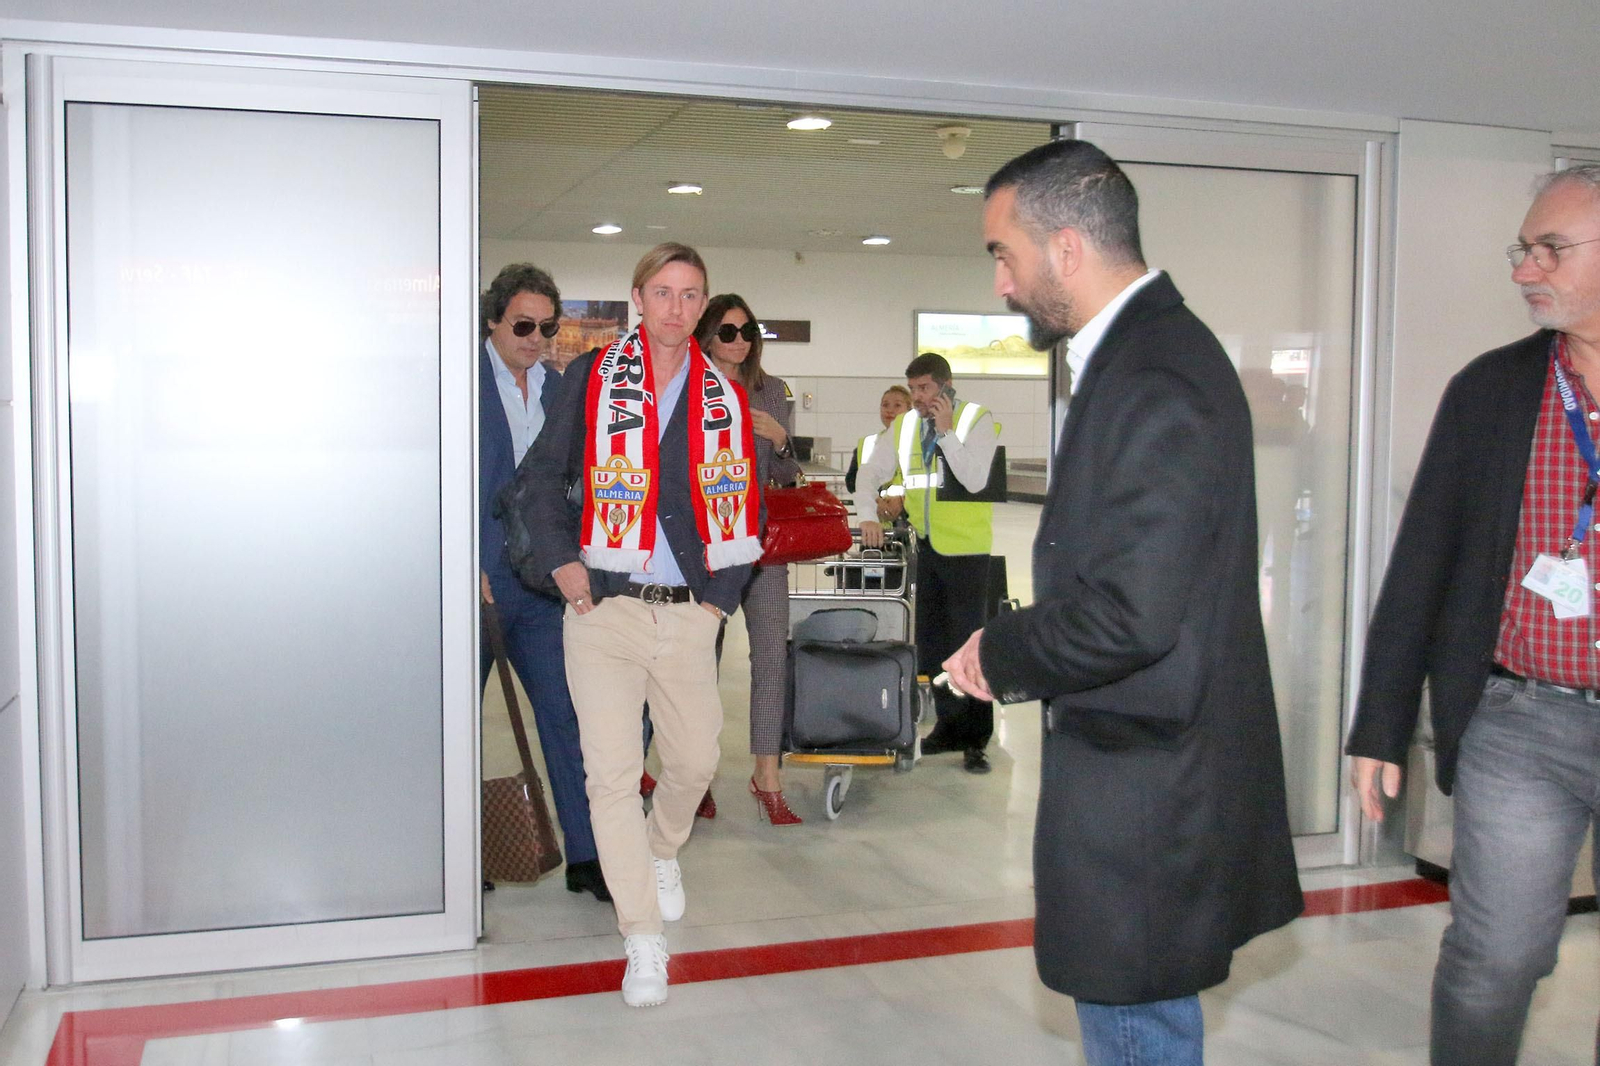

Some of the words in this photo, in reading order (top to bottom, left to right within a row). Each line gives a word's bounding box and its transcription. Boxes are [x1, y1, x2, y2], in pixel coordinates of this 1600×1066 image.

[702, 369, 733, 431] UD
[597, 472, 609, 484] U
[630, 474, 644, 485] D
[704, 468, 715, 480] U
[733, 464, 745, 476] D
[596, 489, 642, 501] ALMERIA
[705, 482, 745, 495] ALMERIA
[1554, 581, 1583, 603] 20
